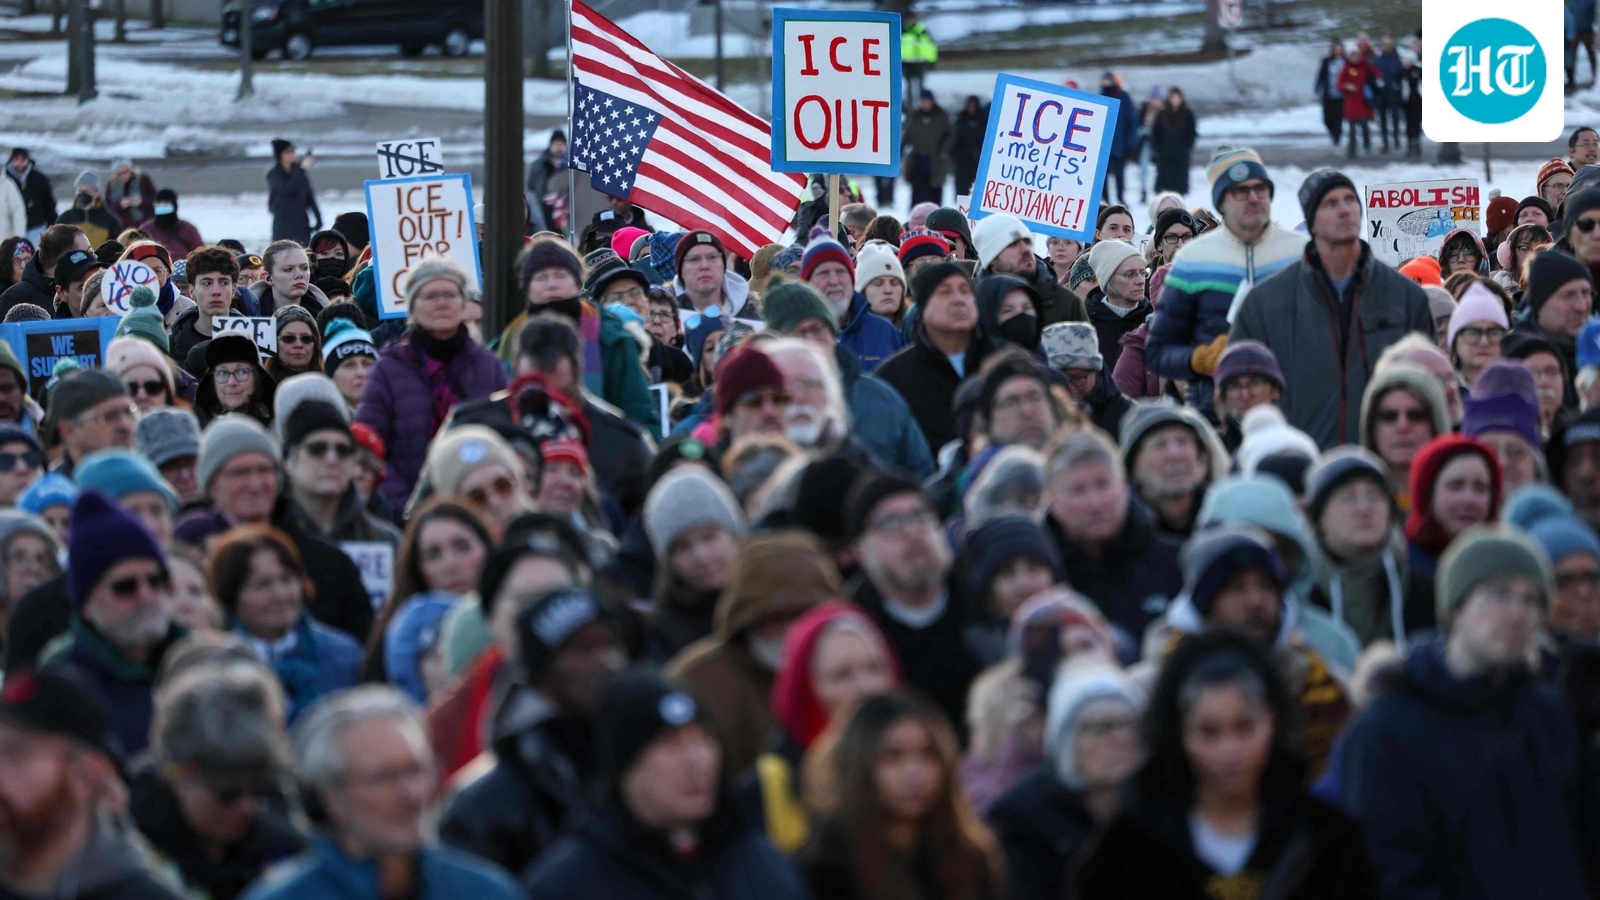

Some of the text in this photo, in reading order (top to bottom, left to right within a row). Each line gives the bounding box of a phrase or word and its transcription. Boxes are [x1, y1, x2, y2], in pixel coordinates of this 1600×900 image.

[798, 34, 881, 76] ICE
[793, 95, 889, 153] OUT
[1008, 92, 1094, 153] ICE
[381, 141, 438, 178] ICE
[1007, 141, 1080, 175] melts
[1001, 163, 1060, 191] under
[396, 182, 447, 216] ICE
[982, 180, 1085, 230] RESISTANCE!
[1368, 186, 1480, 209] ABOLISH
[1450, 206, 1480, 222] ICE
[398, 210, 464, 243] OUT!
[114, 264, 150, 284] NO
[109, 282, 134, 312] IC
[50, 335, 76, 356] WE
